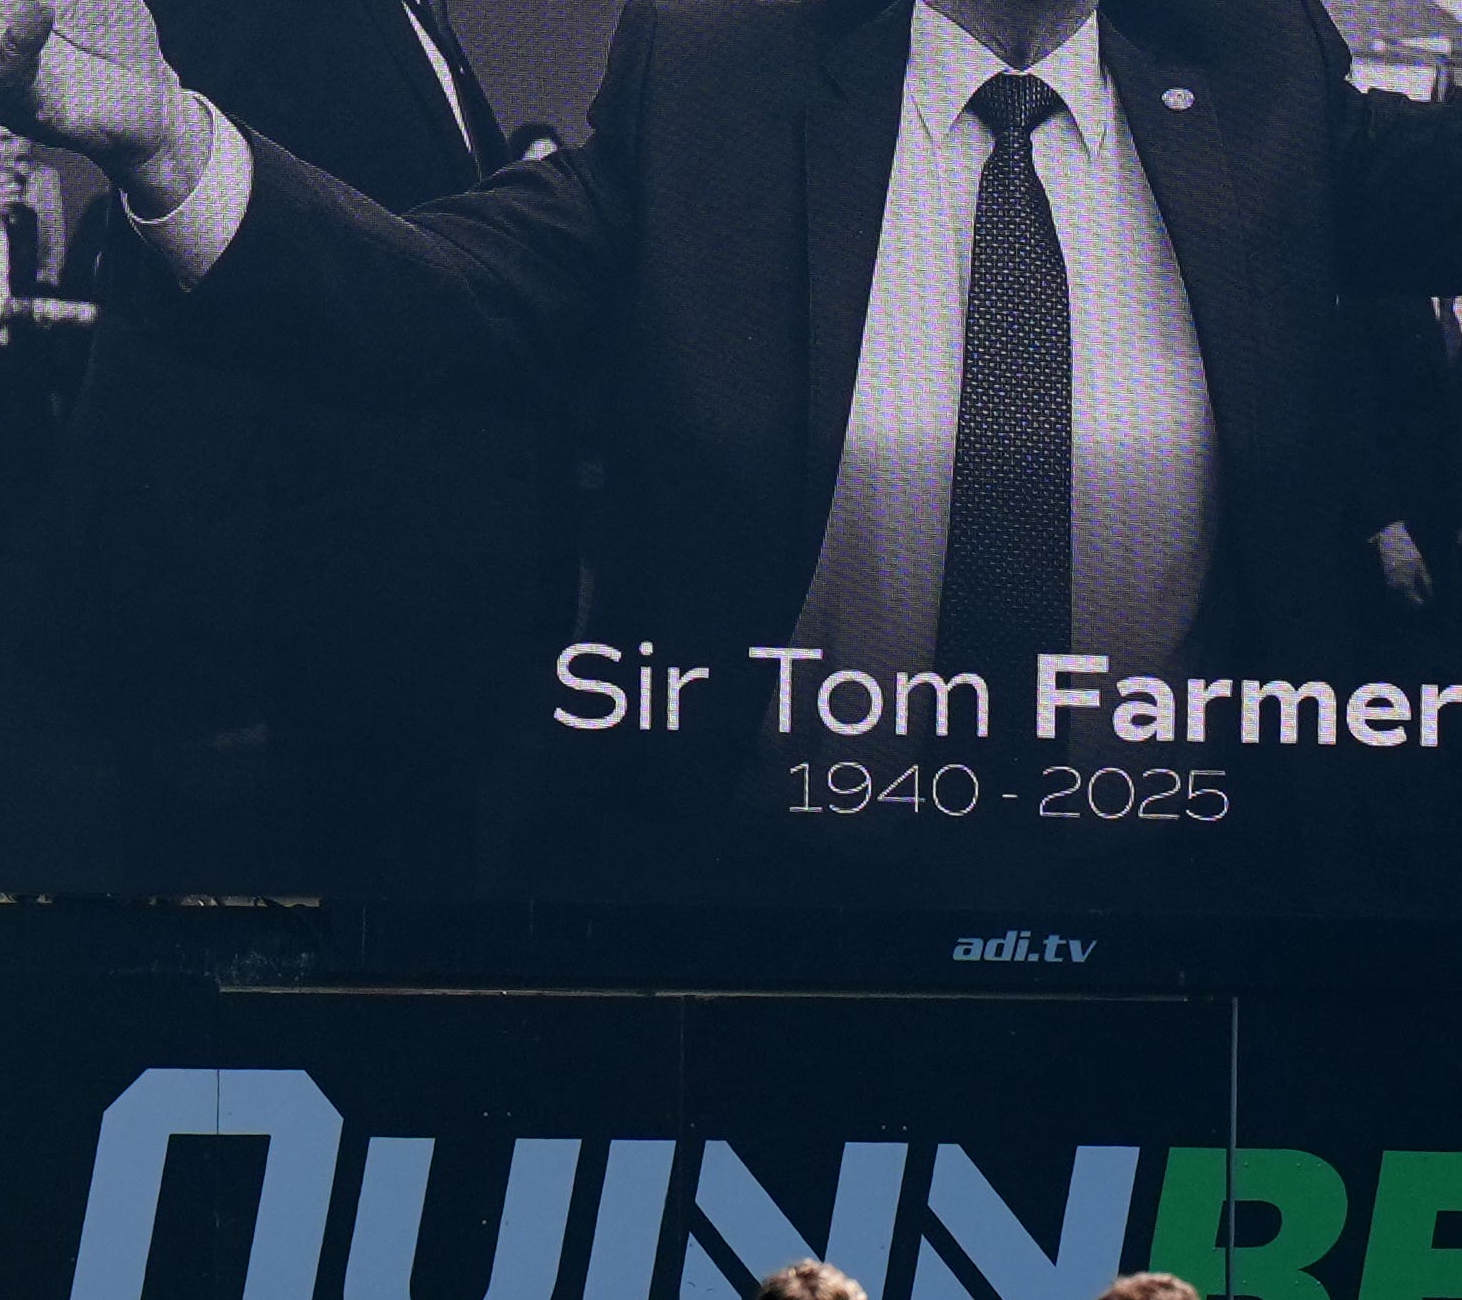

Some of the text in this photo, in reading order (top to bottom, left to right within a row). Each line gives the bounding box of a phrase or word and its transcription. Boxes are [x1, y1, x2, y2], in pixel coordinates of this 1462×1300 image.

[551, 639, 710, 733] Sir
[748, 646, 989, 740] Tom
[788, 761, 981, 818] 1940
[1037, 764, 1232, 823] 2025
[951, 927, 1098, 967] adi.tv
